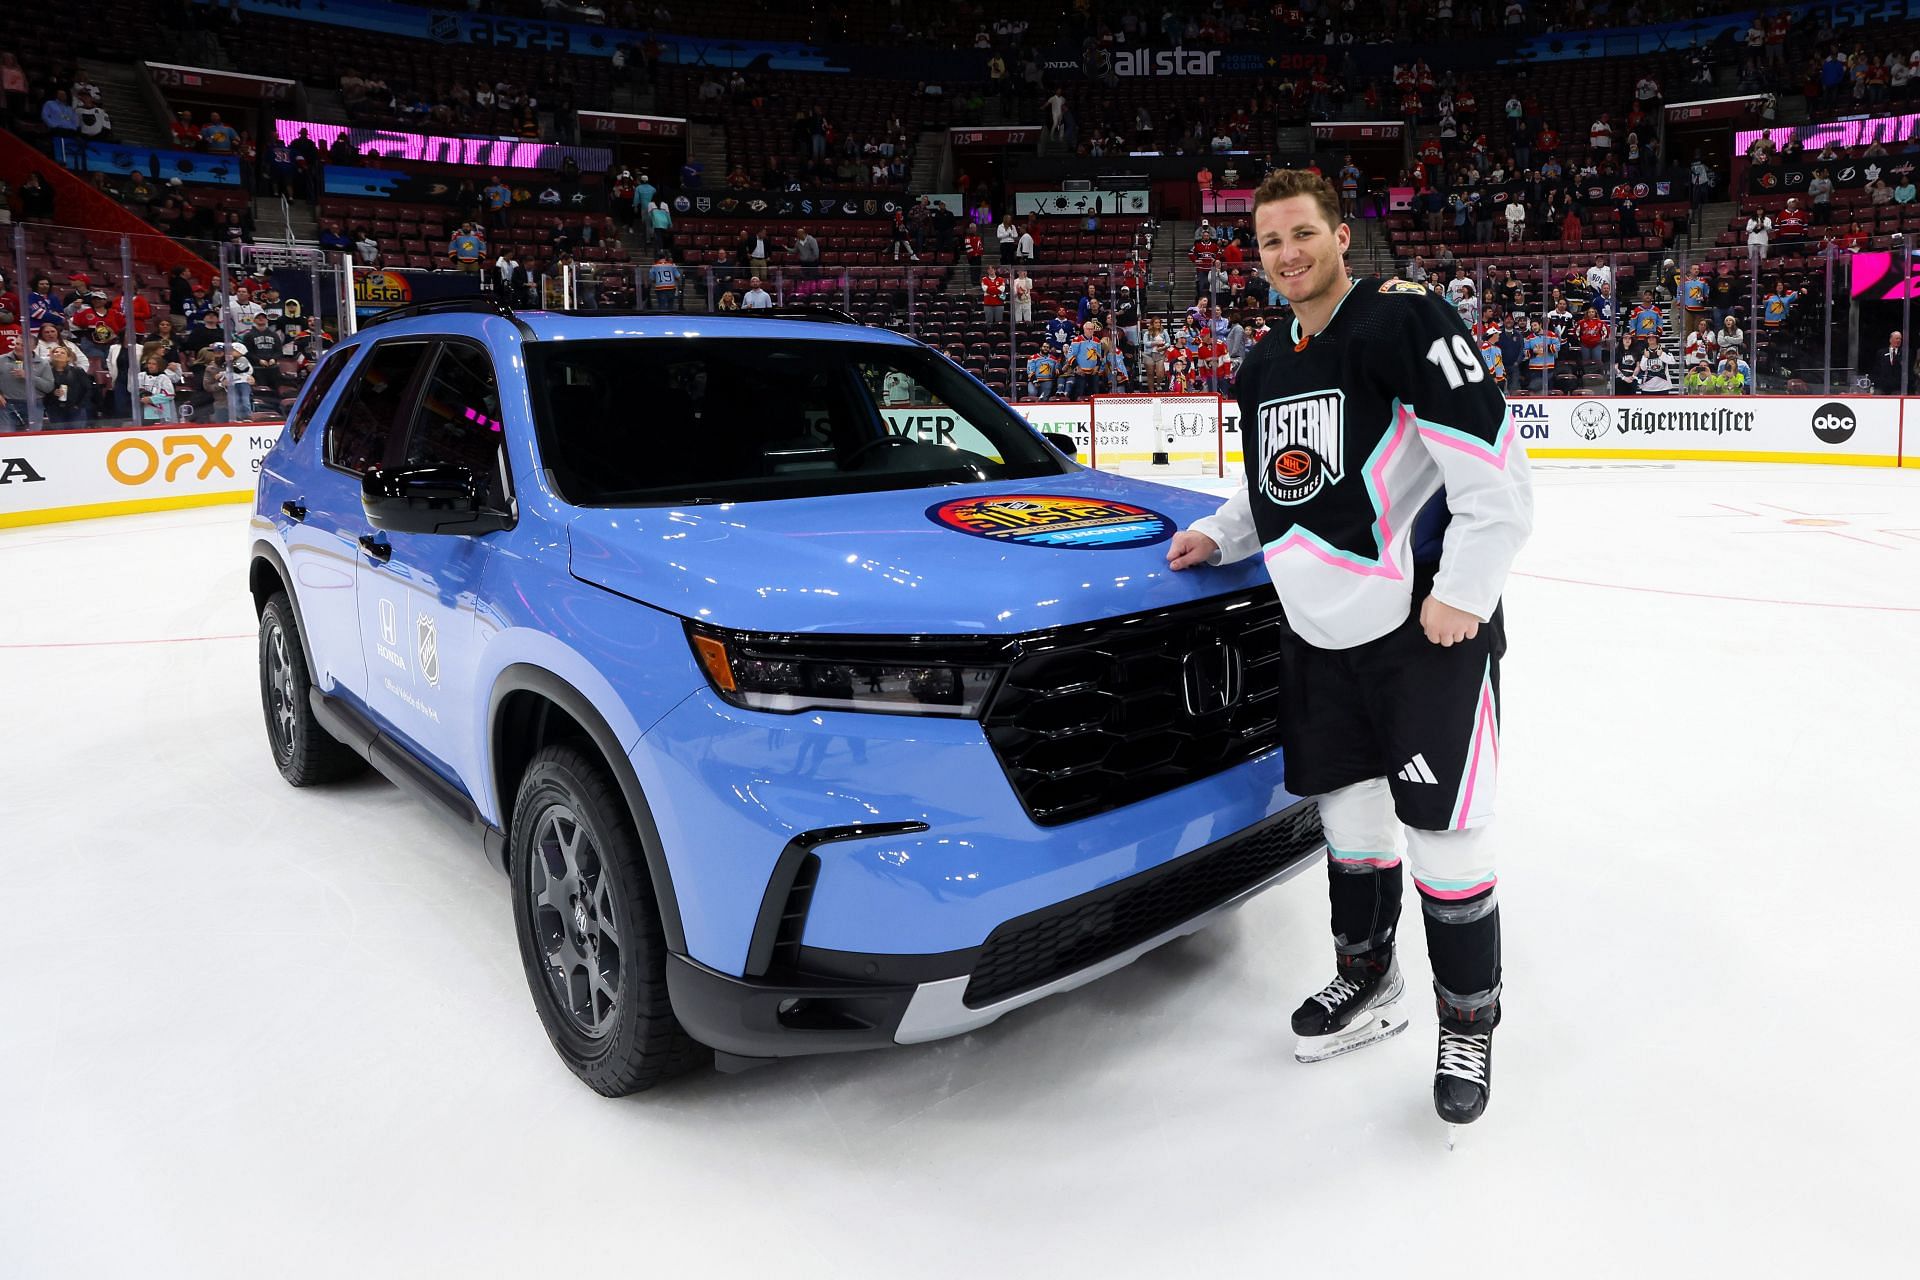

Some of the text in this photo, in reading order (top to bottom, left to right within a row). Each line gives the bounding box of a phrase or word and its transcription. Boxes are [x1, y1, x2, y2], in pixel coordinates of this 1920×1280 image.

[1114, 45, 1222, 76] all star
[1221, 62, 1264, 71] FLORIDA
[1669, 108, 1689, 121] 128
[595, 118, 616, 131] 124
[659, 124, 679, 136] 125
[1380, 126, 1400, 138] 128
[954, 133, 971, 145] 125
[1007, 133, 1025, 144] 127
[1316, 127, 1334, 138] 127
[657, 270, 672, 283] 19
[371, 282, 407, 301] star
[1426, 334, 1485, 390] 19
[1507, 404, 1549, 419] RAL
[1814, 412, 1855, 431] abc
[885, 415, 957, 447] VER
[1261, 396, 1338, 479] EASTERN
[106, 433, 235, 486] OFX
[1283, 456, 1301, 471] NHL
[1268, 474, 1320, 499] CONFERENCE
[1074, 517, 1125, 528] FLORIDA
[1071, 525, 1147, 537] HONDA
[377, 643, 407, 671] HONDA
[422, 636, 434, 667] NHL
